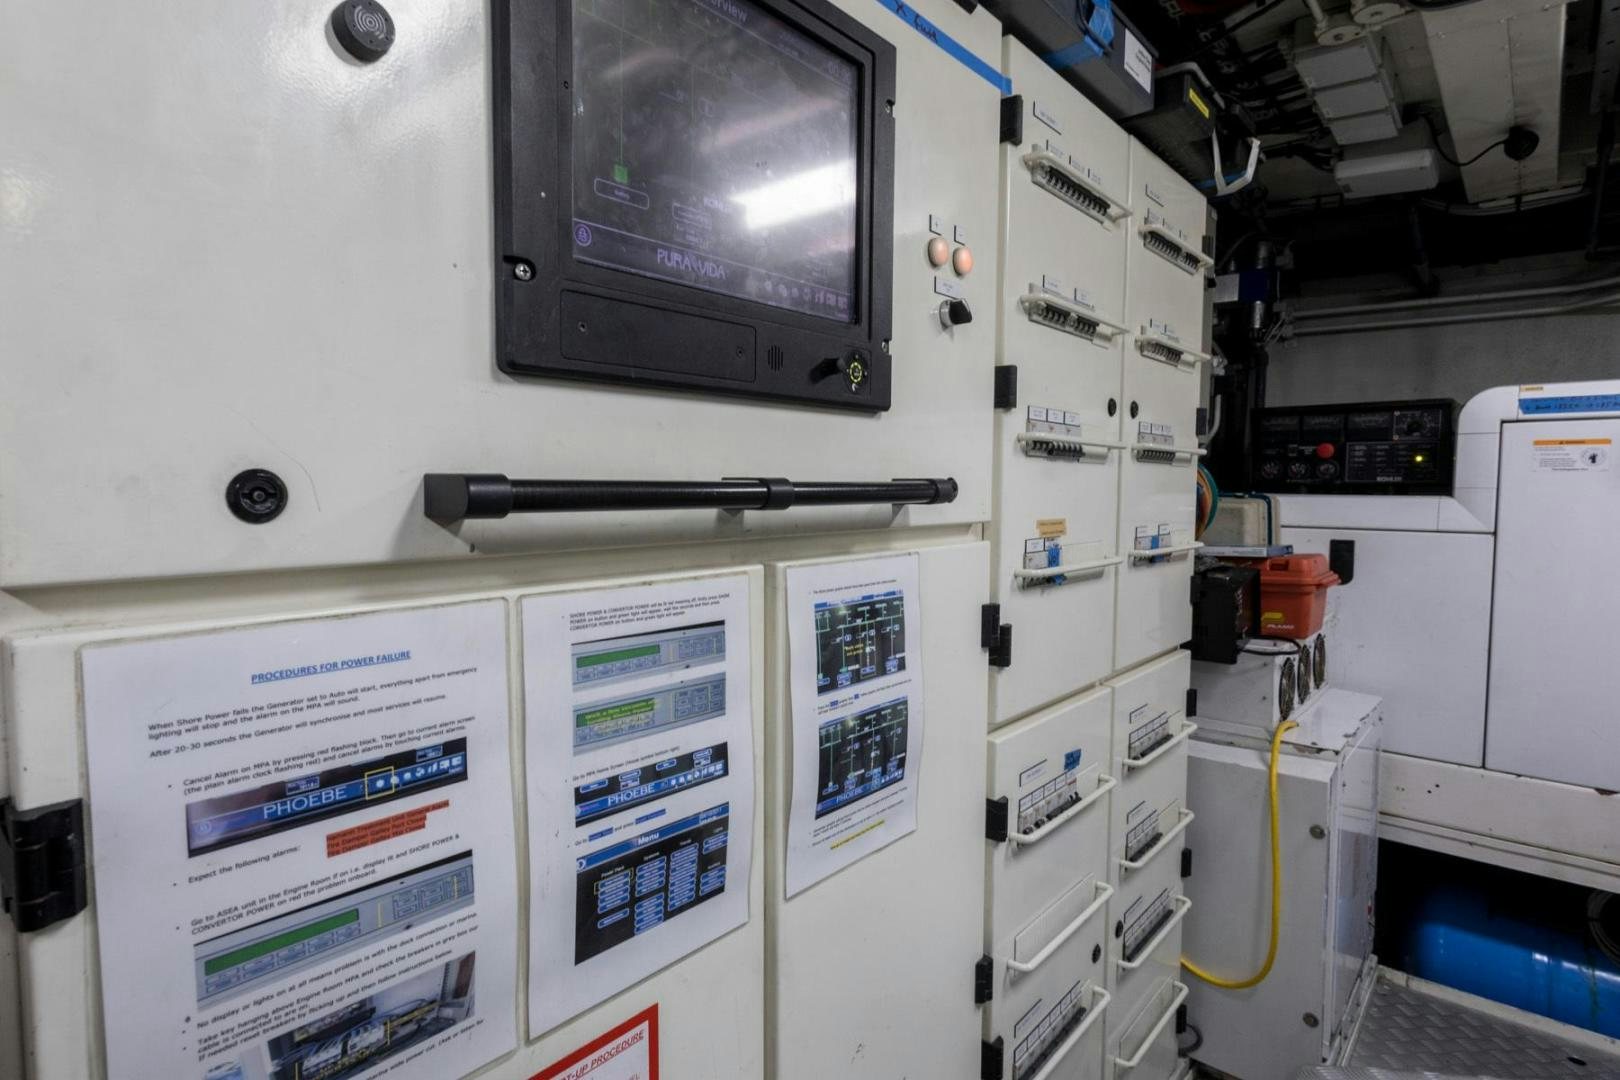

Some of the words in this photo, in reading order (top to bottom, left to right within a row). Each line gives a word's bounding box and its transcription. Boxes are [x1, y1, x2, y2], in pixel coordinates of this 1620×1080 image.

[657, 248, 691, 271] PURA
[698, 260, 727, 279] VIDA
[252, 665, 317, 684] PROCEDURES
[320, 662, 338, 672] FOR
[341, 656, 374, 669] POWER
[376, 651, 411, 664] FAILURE
[149, 722, 173, 731] When
[177, 717, 202, 726] Shore
[205, 712, 230, 721] Power
[233, 708, 248, 716] fails
[252, 704, 264, 712] the
[267, 698, 304, 709] Generator
[330, 690, 345, 698] Auto
[361, 685, 378, 693] start,
[380, 679, 413, 689] everything
[415, 675, 430, 683] apart
[447, 667, 477, 676] emergency
[149, 729, 182, 741] lighting
[185, 725, 198, 733] will
[202, 722, 220, 731] stop
[223, 718, 237, 726] and
[256, 711, 277, 719] alarm
[292, 705, 304, 713] the
[151, 749, 171, 758] After
[175, 743, 200, 753] 20-30
[204, 736, 236, 747] seconds
[255, 725, 292, 737] Generator
[295, 721, 307, 729] will
[310, 714, 350, 727] synchronise
[386, 703, 410, 711] services
[183, 775, 212, 786] Cancel
[215, 769, 238, 779] Alarm
[254, 761, 269, 770] MPA
[272, 758, 281, 767] by
[284, 751, 315, 764] pressing
[317, 747, 328, 755] red
[331, 742, 357, 753] flashing
[416, 725, 437, 734] current
[439, 720, 455, 728] alarm
[457, 716, 475, 724] screen
[184, 786, 202, 796] (the
[205, 781, 224, 791] plain
[227, 775, 250, 785] alarm
[253, 769, 272, 779] clock
[274, 762, 303, 774] flashing
[306, 757, 321, 766] red)
[338, 750, 359, 759] cancel
[362, 745, 383, 753] alarms
[395, 736, 421, 747] touching
[423, 731, 444, 739] current
[263, 785, 348, 819] PHOEBE
[608, 784, 655, 806] PHOEBE
[638, 832, 660, 846] Menu
[189, 869, 216, 884] Expect
[220, 865, 232, 873] the
[235, 855, 270, 869] following
[191, 917, 203, 926] Go
[217, 906, 238, 918] ASEA
[241, 900, 256, 909] unit
[269, 892, 281, 900] the
[283, 884, 308, 896] Engine
[310, 876, 331, 886] Room
[363, 858, 385, 870] display
[409, 845, 430, 855] SHORE
[432, 837, 453, 848] POWER
[192, 912, 243, 935] CONVERTOR
[246, 902, 274, 916] POWER
[277, 899, 286, 907] on
[289, 894, 301, 903] red
[304, 890, 315, 898] the
[318, 880, 346, 894] problem
[197, 1021, 208, 1029] No
[211, 1009, 239, 1023] display
[253, 995, 274, 1006] lights
[298, 980, 307, 988] all
[309, 972, 332, 984] means
[334, 958, 362, 975] problem
[372, 949, 385, 958] with
[388, 944, 398, 952] the
[400, 938, 413, 947] dock
[416, 925, 447, 940] connection
[457, 912, 477, 924] marina
[199, 1033, 218, 1045] Take
[220, 1026, 234, 1039] key
[238, 1011, 269, 1028] hanging
[272, 1002, 294, 1015] above
[297, 990, 321, 1005] Engine
[323, 980, 343, 993] Room
[362, 968, 374, 976] and
[376, 960, 393, 971] check
[396, 955, 406, 963] the
[408, 944, 434, 958] breakers
[208, 1042, 238, 1057] needed
[240, 1032, 260, 1043] reset
[263, 1017, 295, 1034] breakers
[298, 1012, 306, 1021] by
[347, 989, 359, 998] and
[362, 981, 376, 991] then
[398, 958, 433, 975] instructions
[199, 1041, 219, 1052] cable
[232, 1018, 272, 1040] connected
[591, 1030, 644, 1070] PROCEDURE
